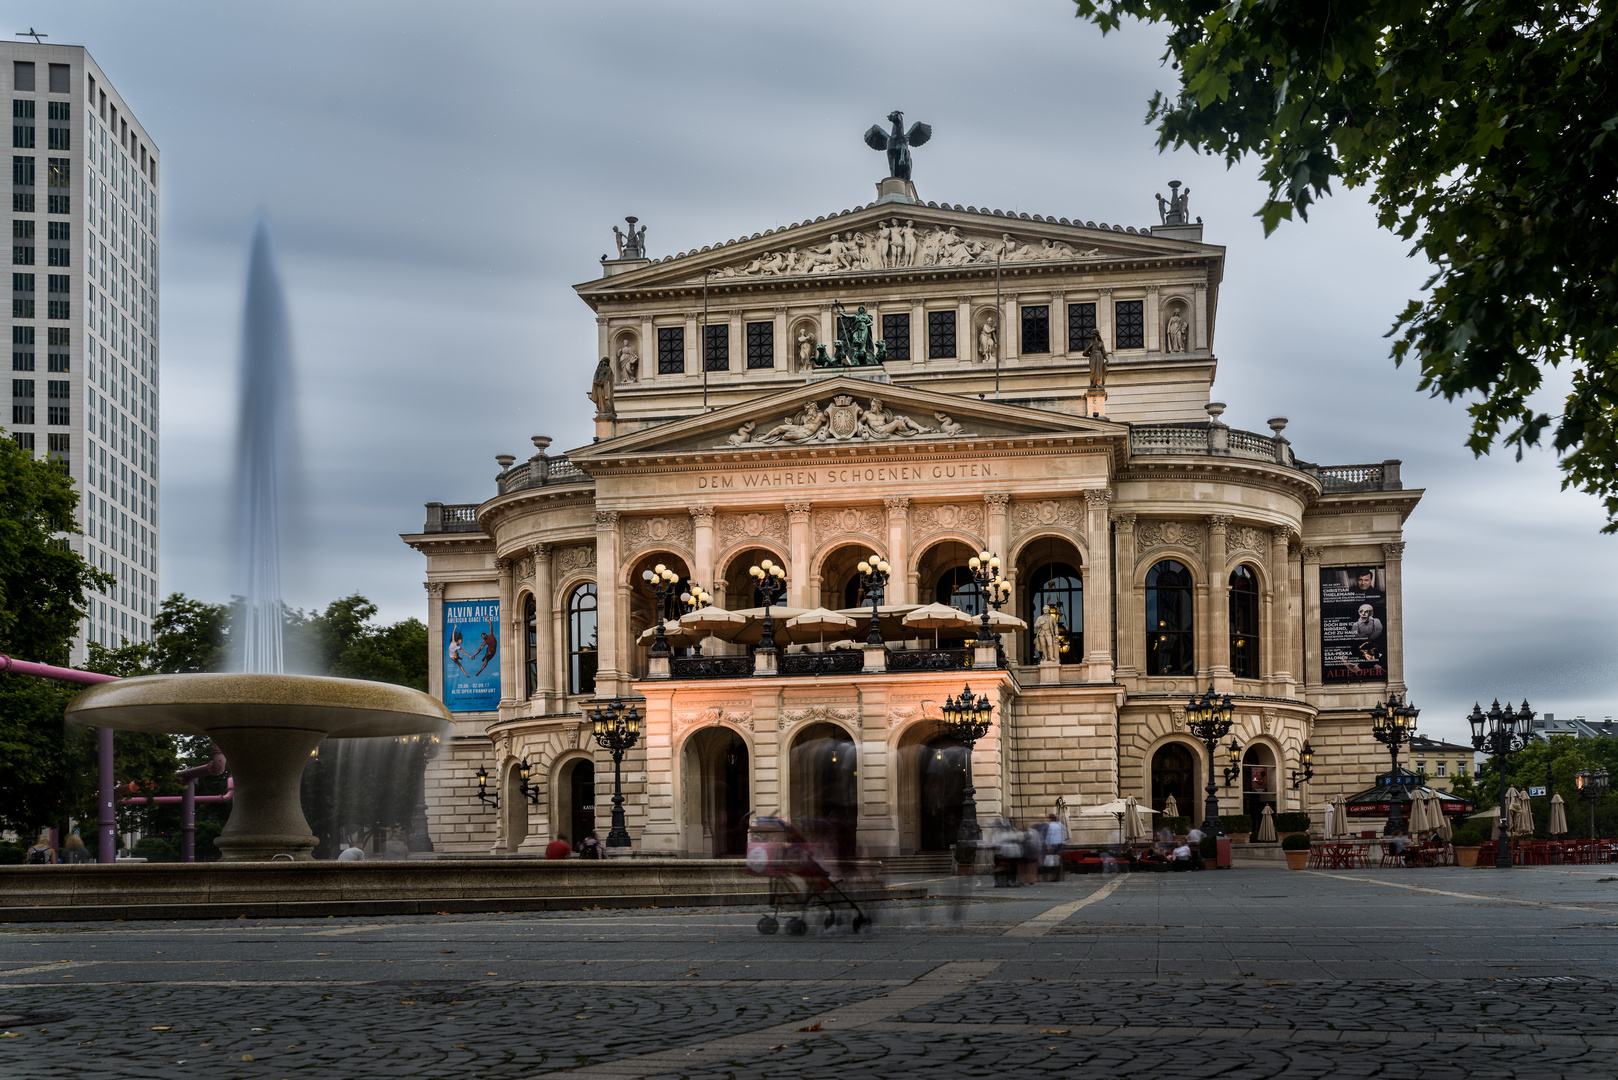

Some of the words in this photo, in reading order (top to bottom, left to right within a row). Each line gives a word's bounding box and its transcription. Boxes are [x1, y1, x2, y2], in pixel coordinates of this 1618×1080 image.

[698, 476, 734, 488] DEM
[742, 472, 816, 486] WAHREN
[828, 466, 922, 483] SCHOENEN
[447, 606, 472, 618] ALVIN
[475, 606, 499, 617] AILEY
[1327, 669, 1353, 677] ALTE
[1355, 668, 1382, 676] OPER
